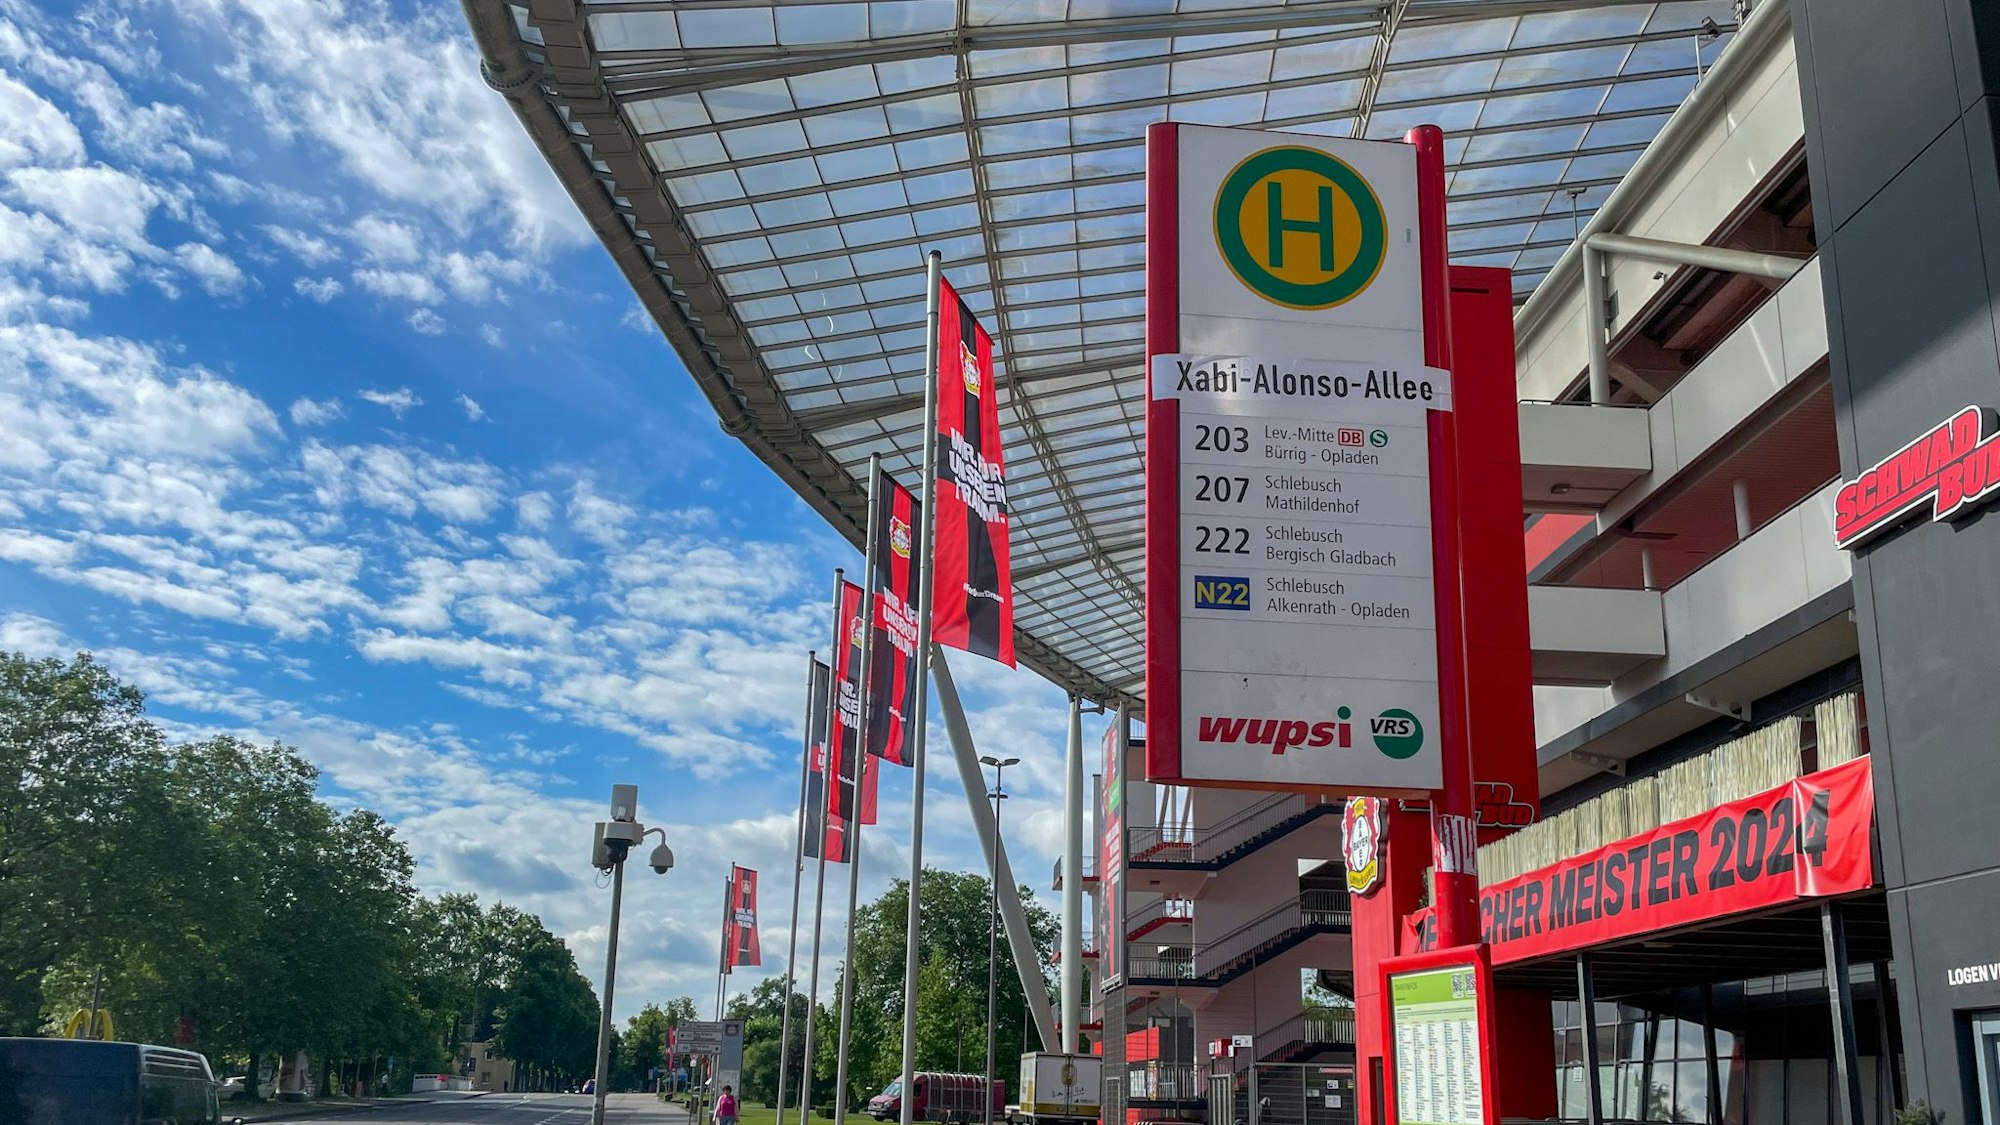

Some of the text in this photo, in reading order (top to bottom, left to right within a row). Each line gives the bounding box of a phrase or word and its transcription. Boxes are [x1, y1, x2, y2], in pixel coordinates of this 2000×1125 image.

[1267, 181, 1335, 272] H
[1176, 360, 1433, 401] Xabi-Alonso-Allee
[1194, 424, 1250, 453] 203
[1264, 424, 1335, 443] Lev.-Mitte
[1340, 430, 1363, 446] DB
[1265, 445, 1307, 465] Bürrig
[1321, 449, 1379, 466] Opladen
[1836, 410, 1978, 531] SCHWAD
[1194, 475, 1250, 503] 207
[1264, 475, 1342, 493] Schlebusch
[1265, 495, 1360, 514] Mathildenhof
[1194, 525, 1251, 555] 222
[1265, 526, 1343, 544] Schlebusch
[1266, 547, 1396, 567] Bergisch Gladbach
[1196, 581, 1249, 606] N22
[1266, 577, 1345, 595] Schlebusch
[1267, 598, 1336, 616] Alkenrath
[1351, 602, 1410, 620] Opladen
[1198, 705, 1352, 755] wupsi
[1369, 717, 1410, 736] VRS
[1548, 829, 1701, 931] MEISTER
[1707, 788, 1831, 892] 2024
[1947, 963, 2000, 986] LOGEN V
